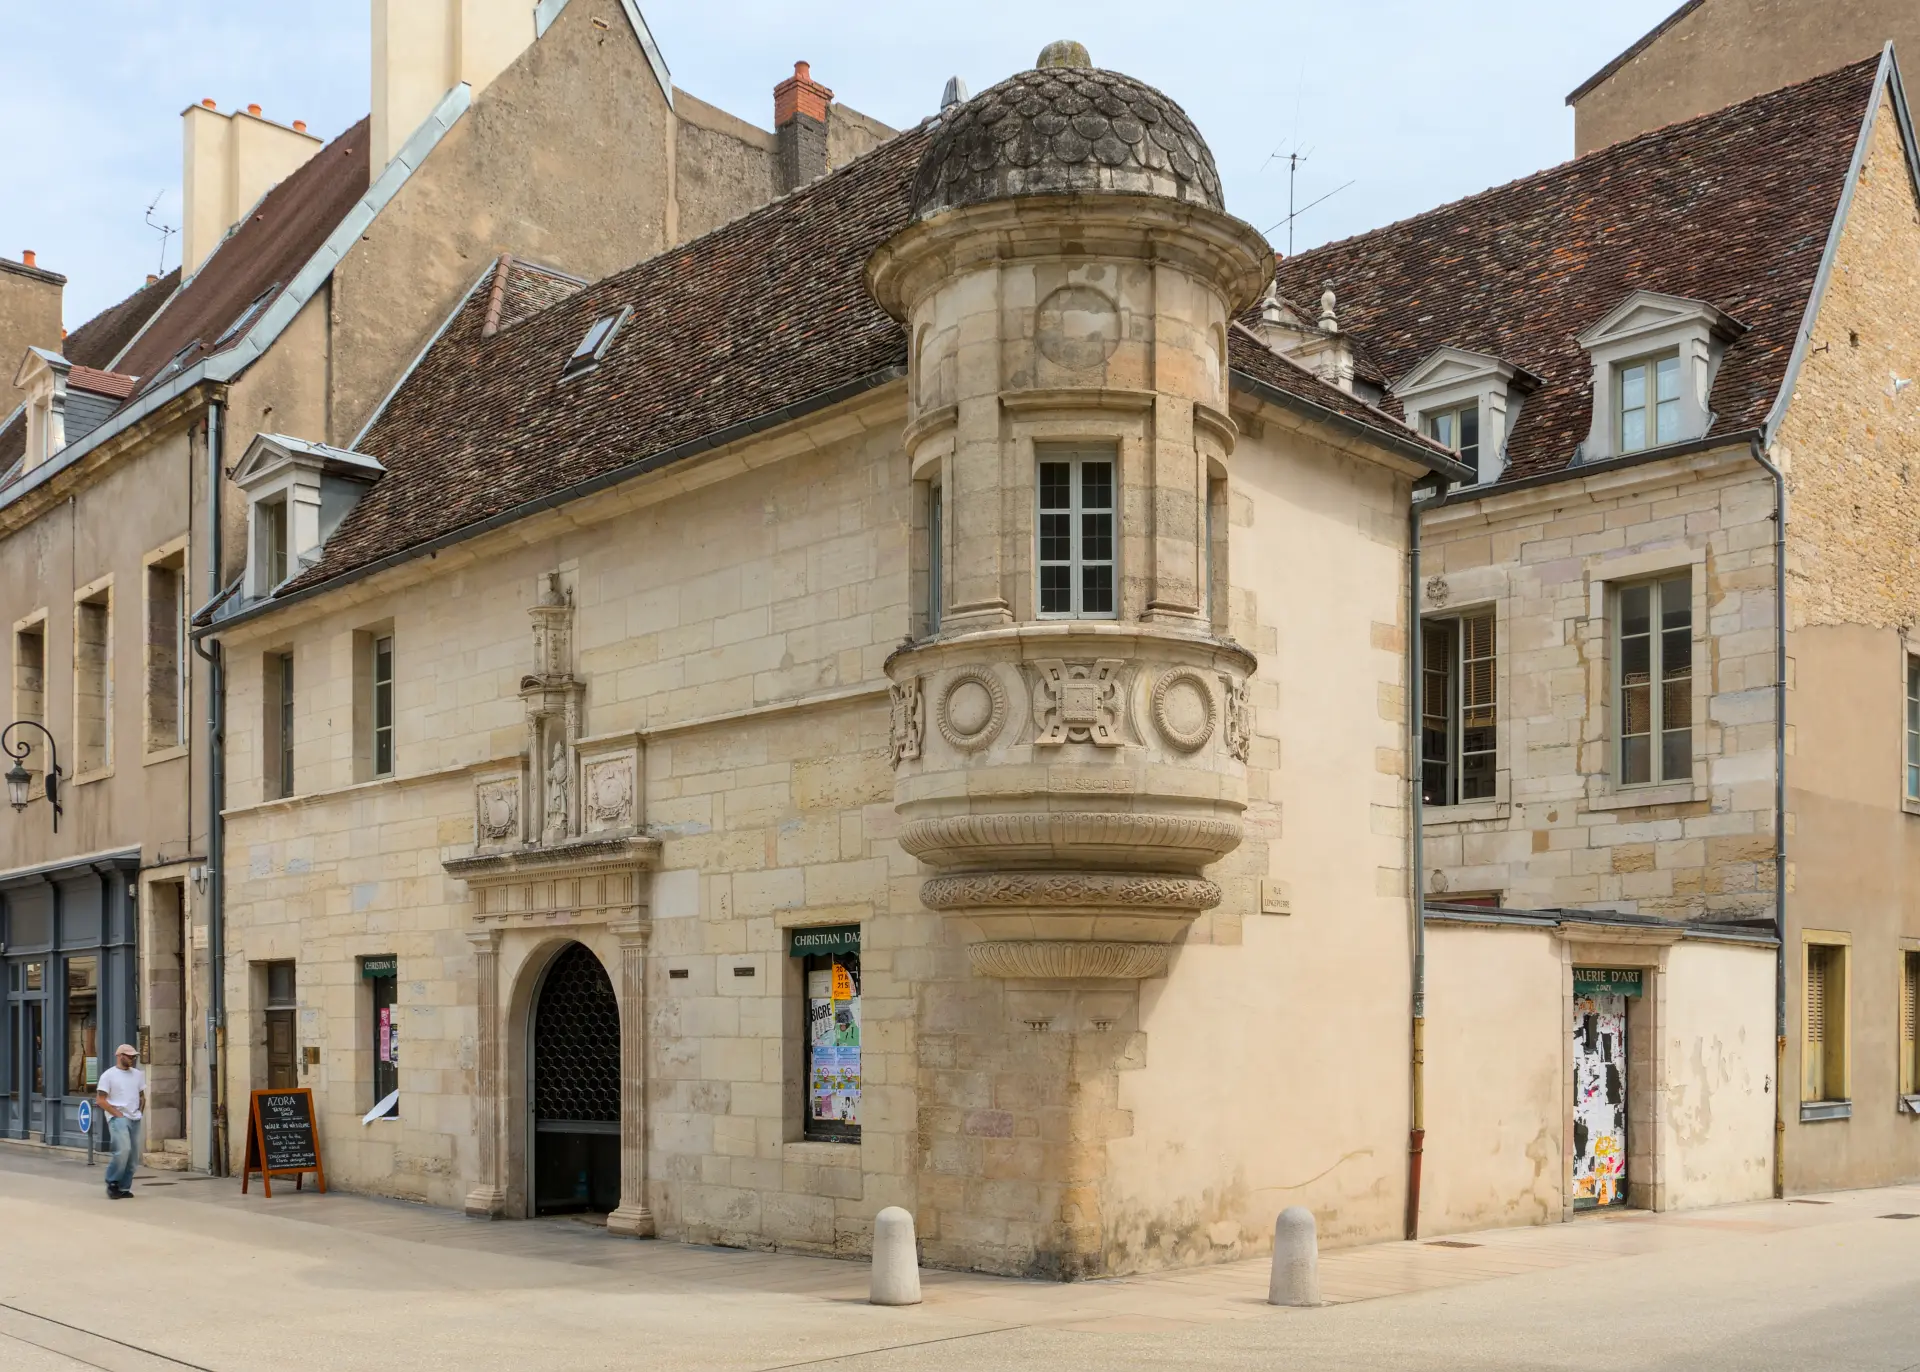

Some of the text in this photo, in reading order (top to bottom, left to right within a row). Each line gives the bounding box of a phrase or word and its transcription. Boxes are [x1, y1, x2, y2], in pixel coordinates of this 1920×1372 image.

[794, 933, 840, 946] CHRISTIAN
[364, 960, 391, 970] CHRISTIAN
[1573, 970, 1640, 983] ALERIE D'ART
[811, 1003, 832, 1022] BIGRE
[267, 1095, 296, 1107] AZORA
